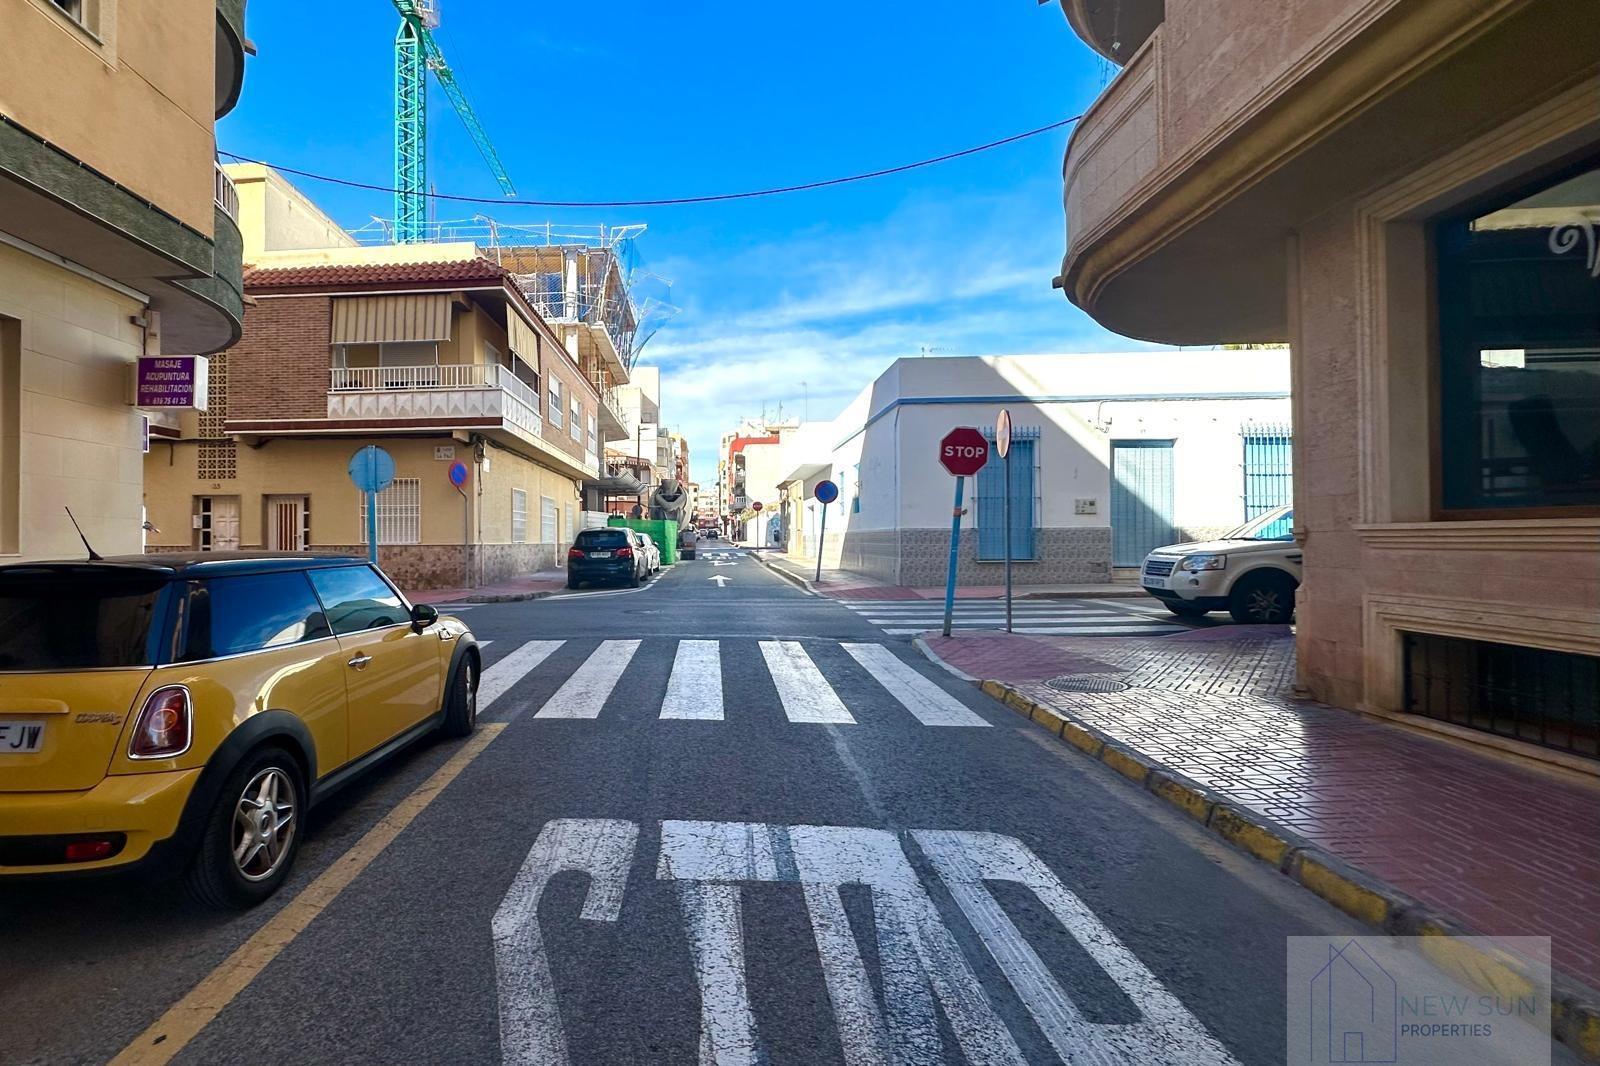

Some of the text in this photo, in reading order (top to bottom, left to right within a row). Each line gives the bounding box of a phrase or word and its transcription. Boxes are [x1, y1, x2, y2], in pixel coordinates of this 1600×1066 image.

[154, 359, 182, 369] MASAJE
[145, 371, 190, 381] ACUPUNTURA
[140, 384, 193, 393] REHABILITACION
[163, 396, 171, 405] 75
[944, 445, 985, 458] STOP
